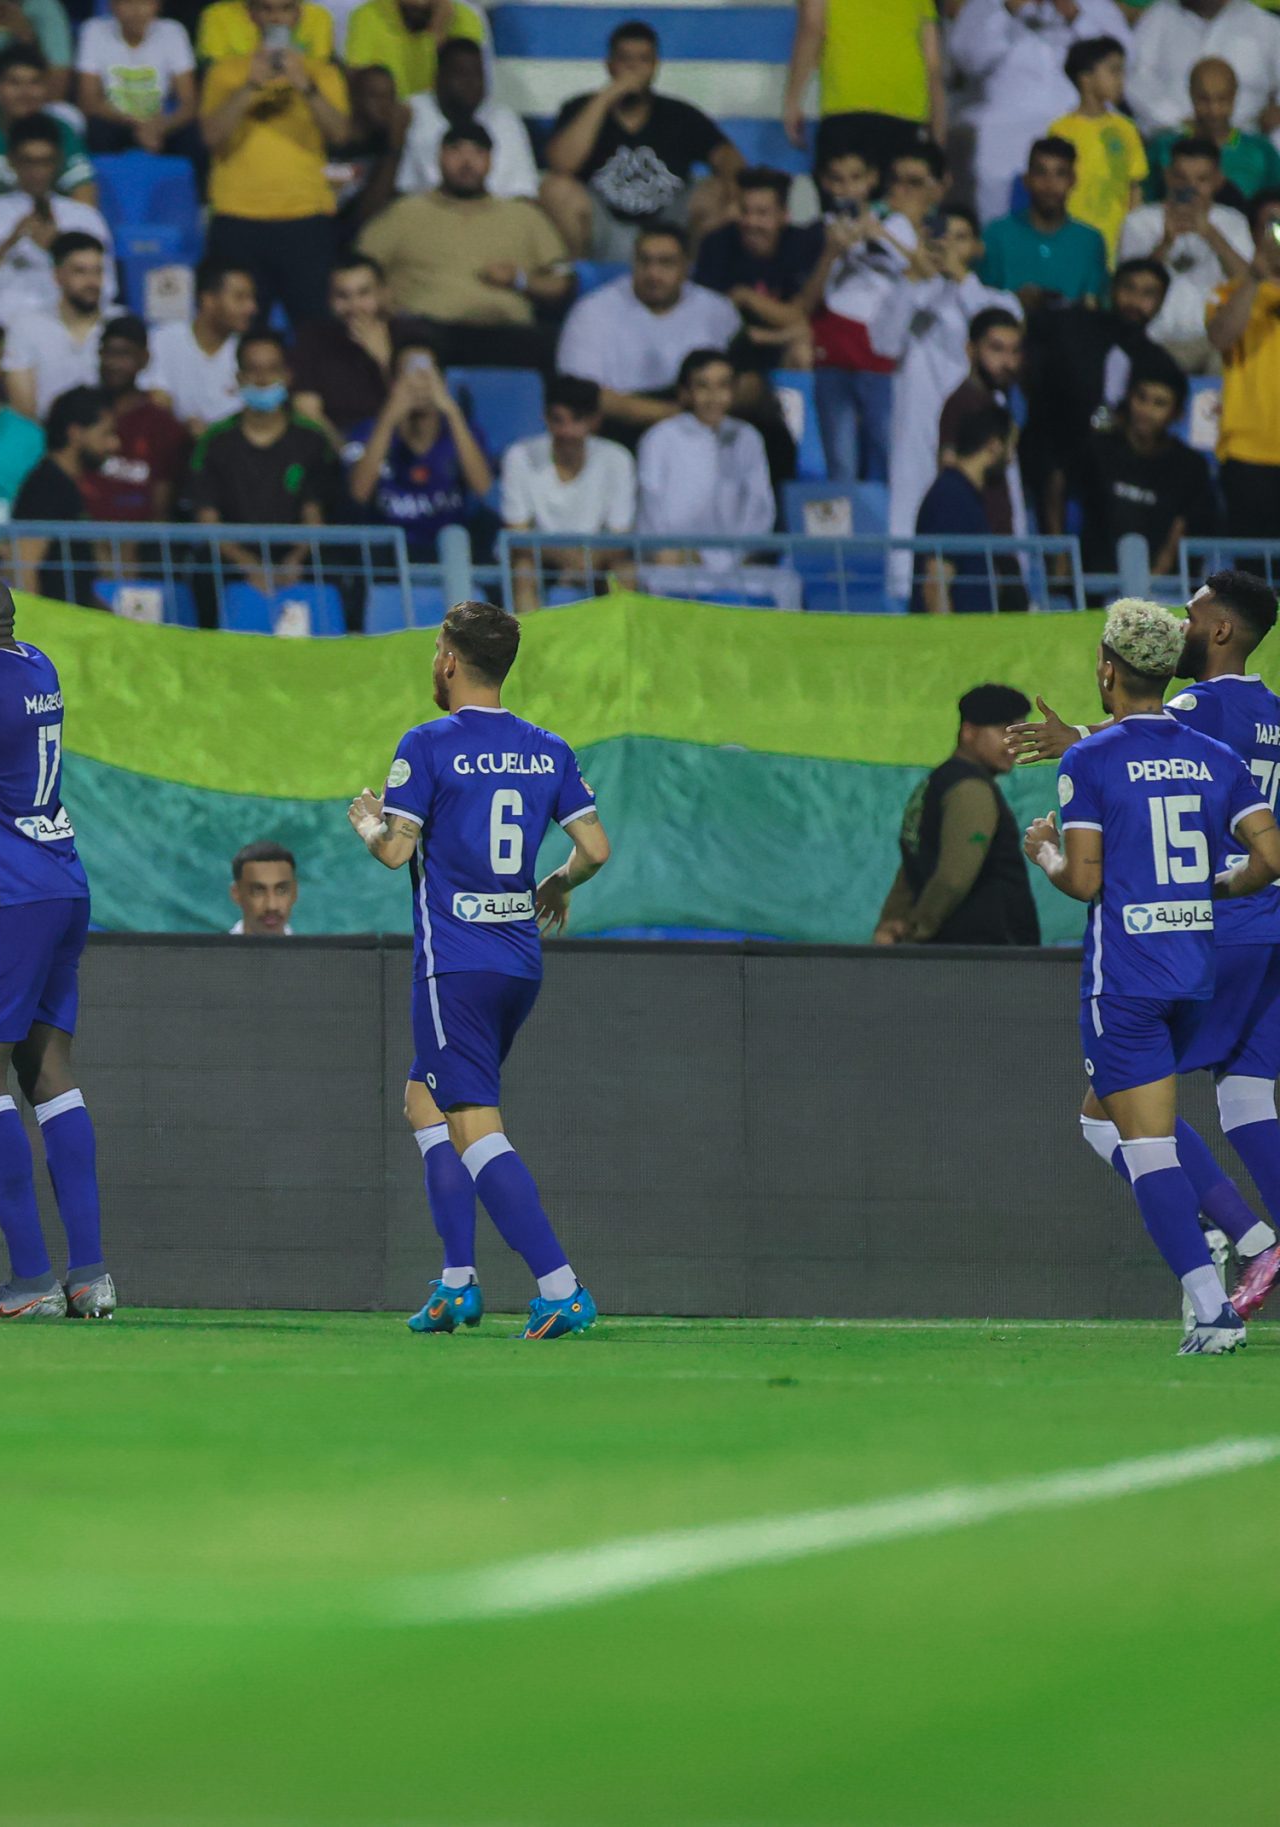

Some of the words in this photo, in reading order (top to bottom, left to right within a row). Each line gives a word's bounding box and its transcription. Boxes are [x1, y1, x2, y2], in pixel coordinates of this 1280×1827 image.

[33, 723, 62, 807] 17
[453, 754, 475, 775] G.
[490, 789, 524, 875] 6
[1148, 795, 1210, 885] 15
